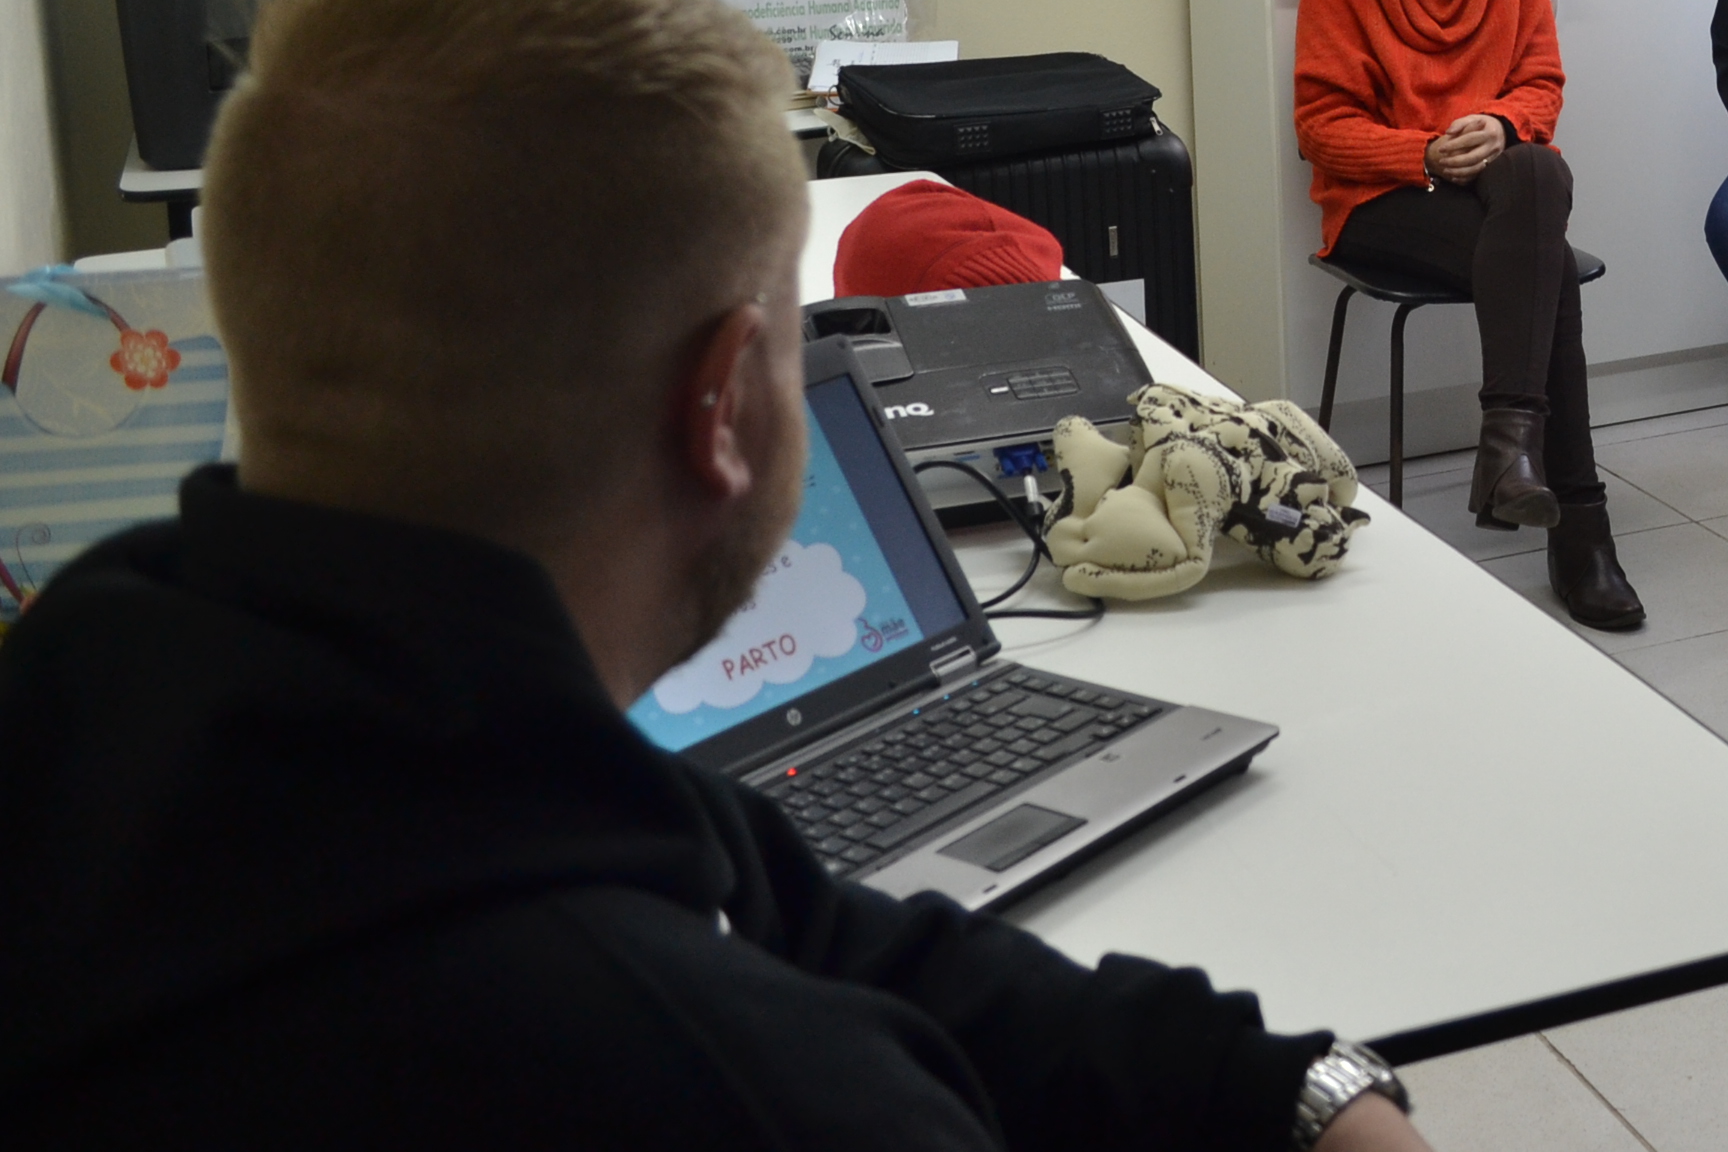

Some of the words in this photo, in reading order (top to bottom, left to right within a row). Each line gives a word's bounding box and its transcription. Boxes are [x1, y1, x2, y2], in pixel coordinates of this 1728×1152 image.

[809, 0, 850, 13] Humana
[884, 402, 935, 419] nQ
[781, 554, 792, 568] e
[721, 633, 797, 680] PARTO
